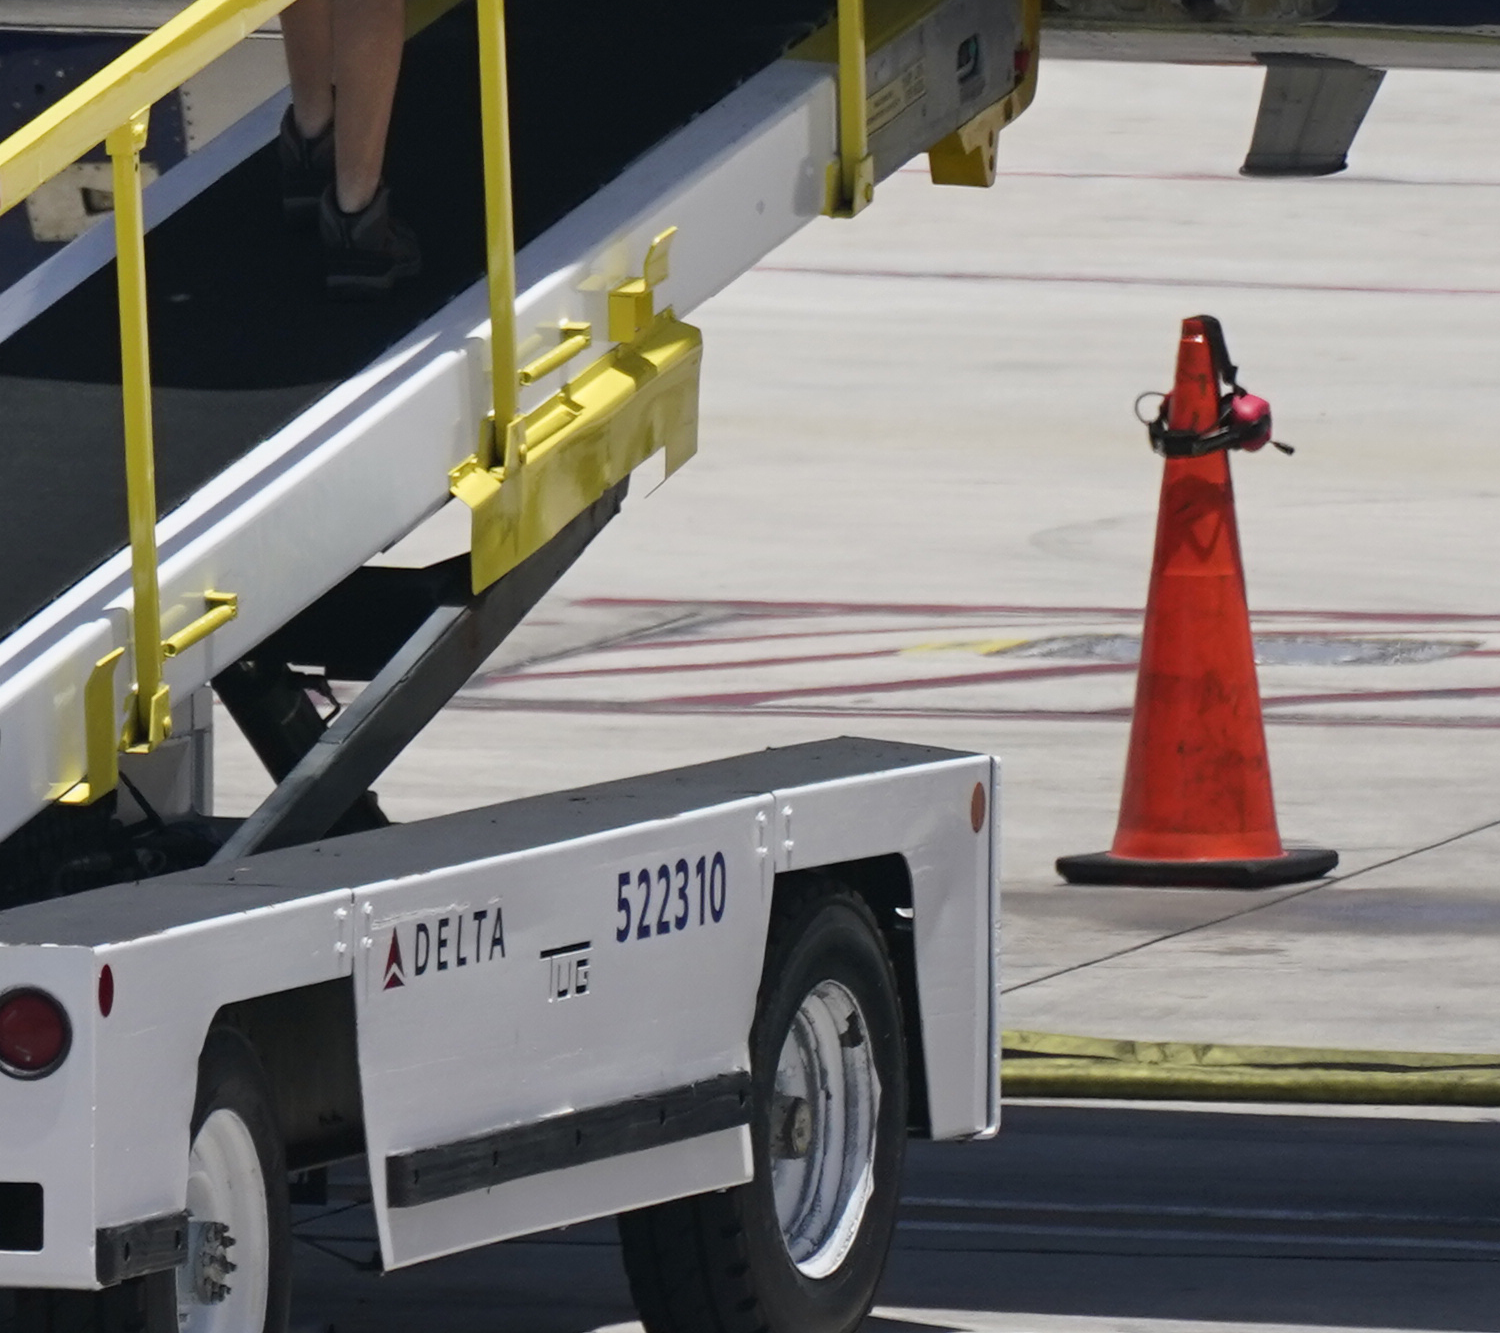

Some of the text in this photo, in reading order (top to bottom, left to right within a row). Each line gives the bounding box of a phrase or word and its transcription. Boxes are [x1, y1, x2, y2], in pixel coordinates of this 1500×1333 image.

[616, 850, 726, 943] 522310
[414, 906, 506, 976] DELTA
[539, 939, 592, 1003] TUG
